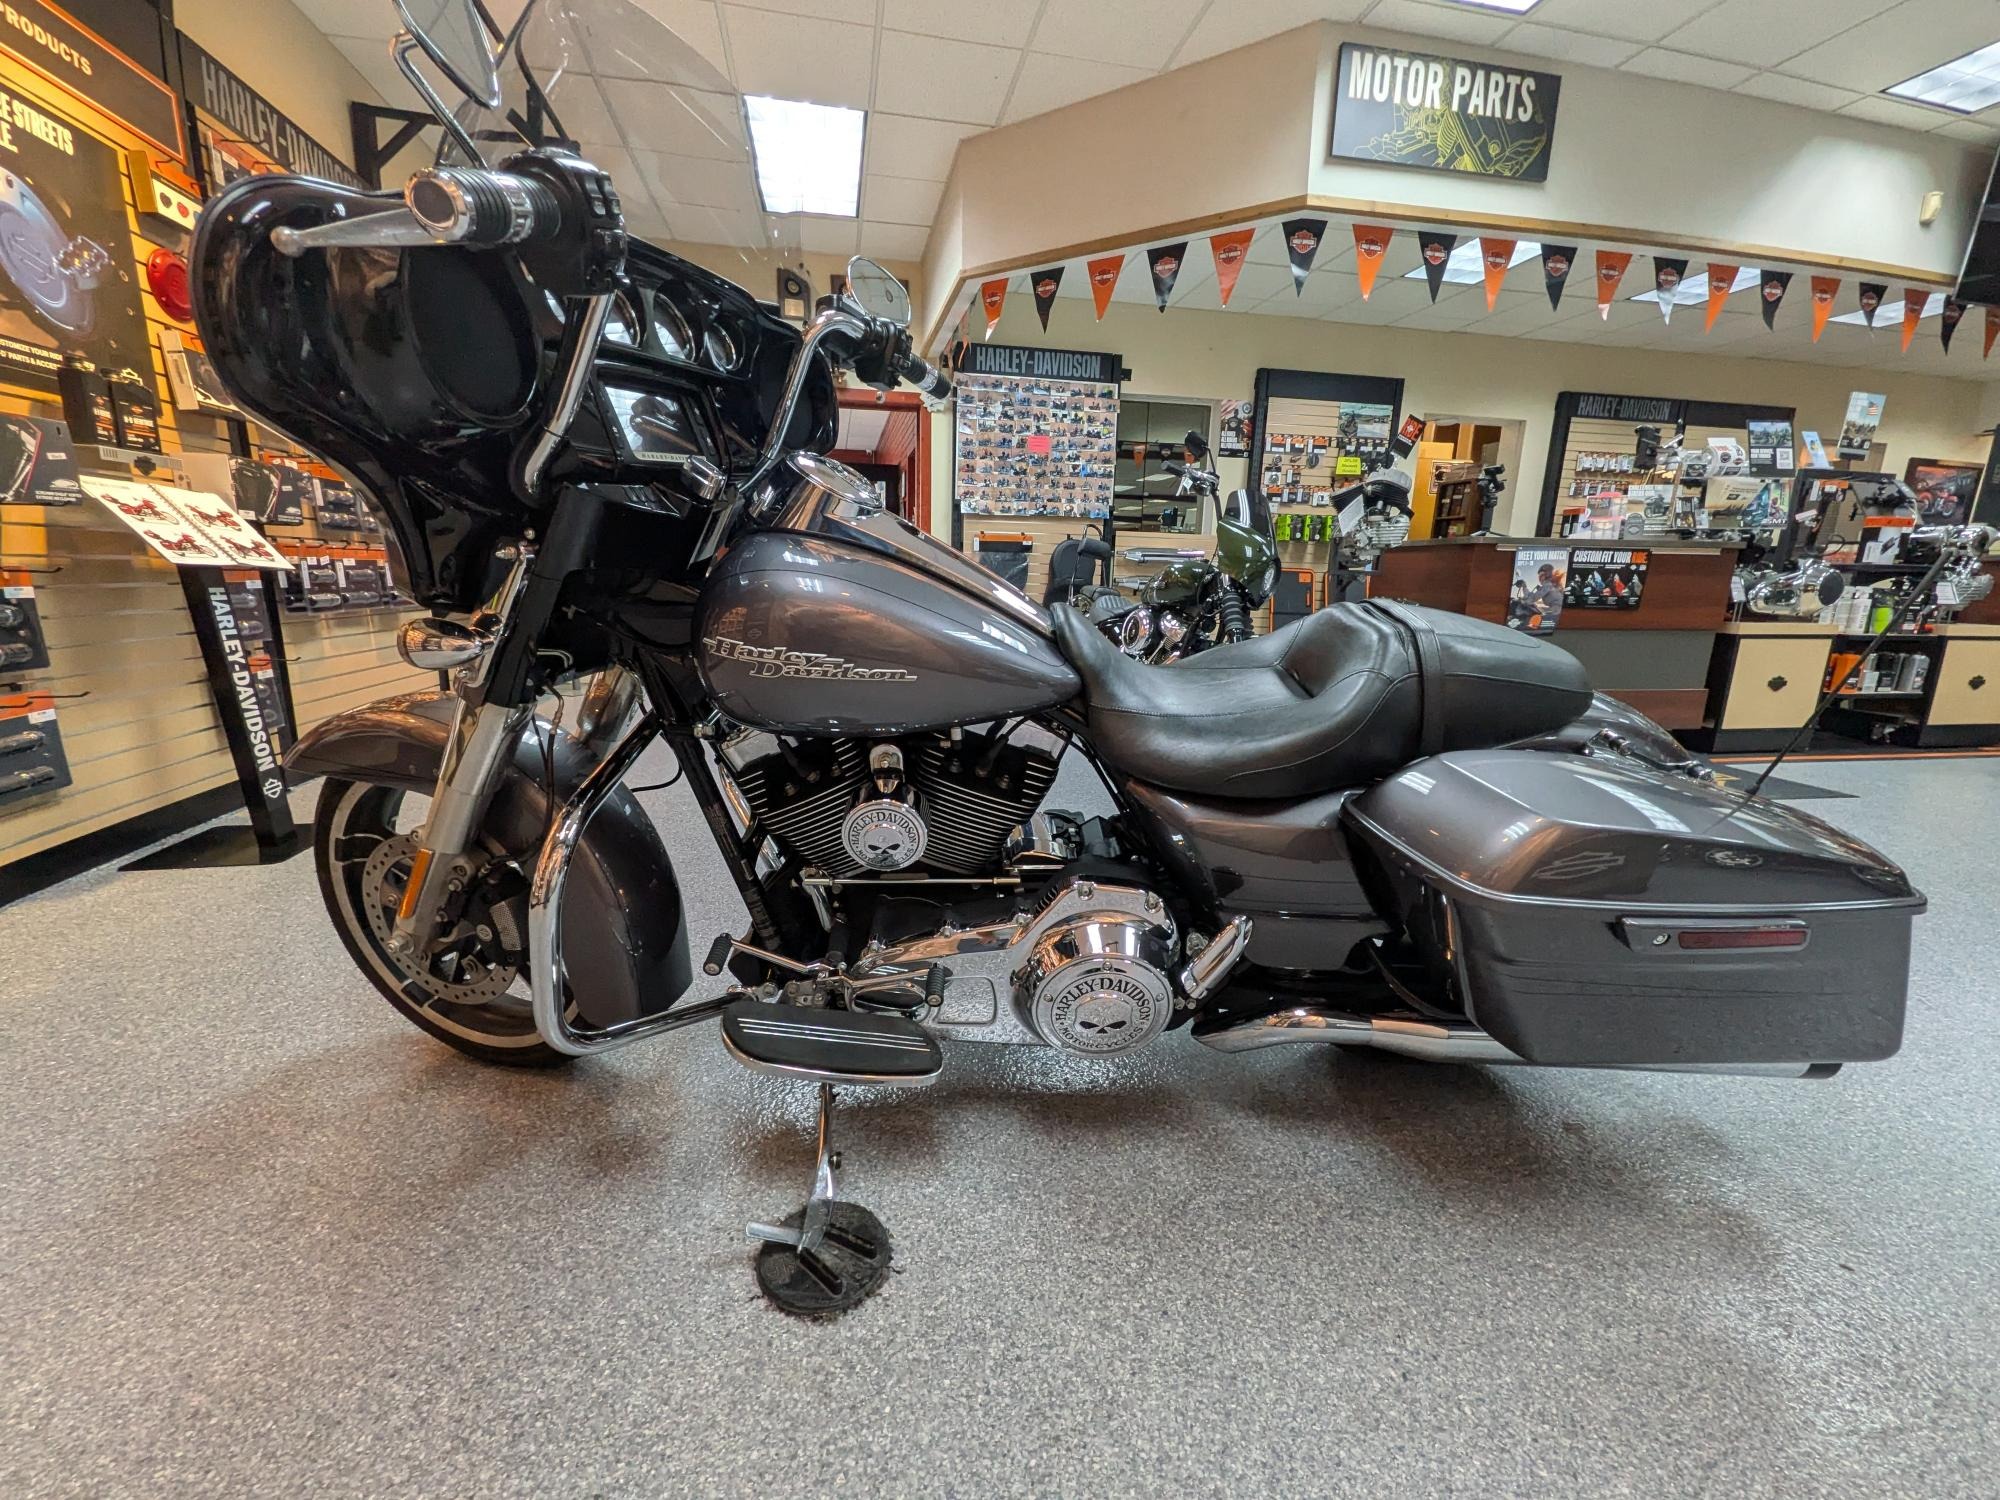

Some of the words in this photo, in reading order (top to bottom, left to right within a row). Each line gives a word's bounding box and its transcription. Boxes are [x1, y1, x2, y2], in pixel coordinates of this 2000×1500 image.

[1348, 51, 1445, 109] MOTOR
[1452, 66, 1536, 123] PARTS
[12, 99, 74, 156] STREETS
[976, 347, 1100, 379] HARLEY-DAVIDSON
[1577, 395, 1671, 420] HARLEY-DAVIDSON
[1518, 550, 1534, 561] MEET
[1533, 550, 1548, 561] YOUR
[1573, 550, 1602, 563] CUSTOM
[1601, 551, 1614, 563] FIT
[1613, 551, 1632, 564] YOUR
[208, 587, 275, 772] HARLEY-DAVIDSON
[750, 659, 917, 681] Davidson
[852, 811, 917, 846] HARLEY-DAVIDSON
[1055, 977, 1152, 1021] HARLEY-DAVIDSON
[1060, 1026, 1144, 1049] MOTORCYCLES
